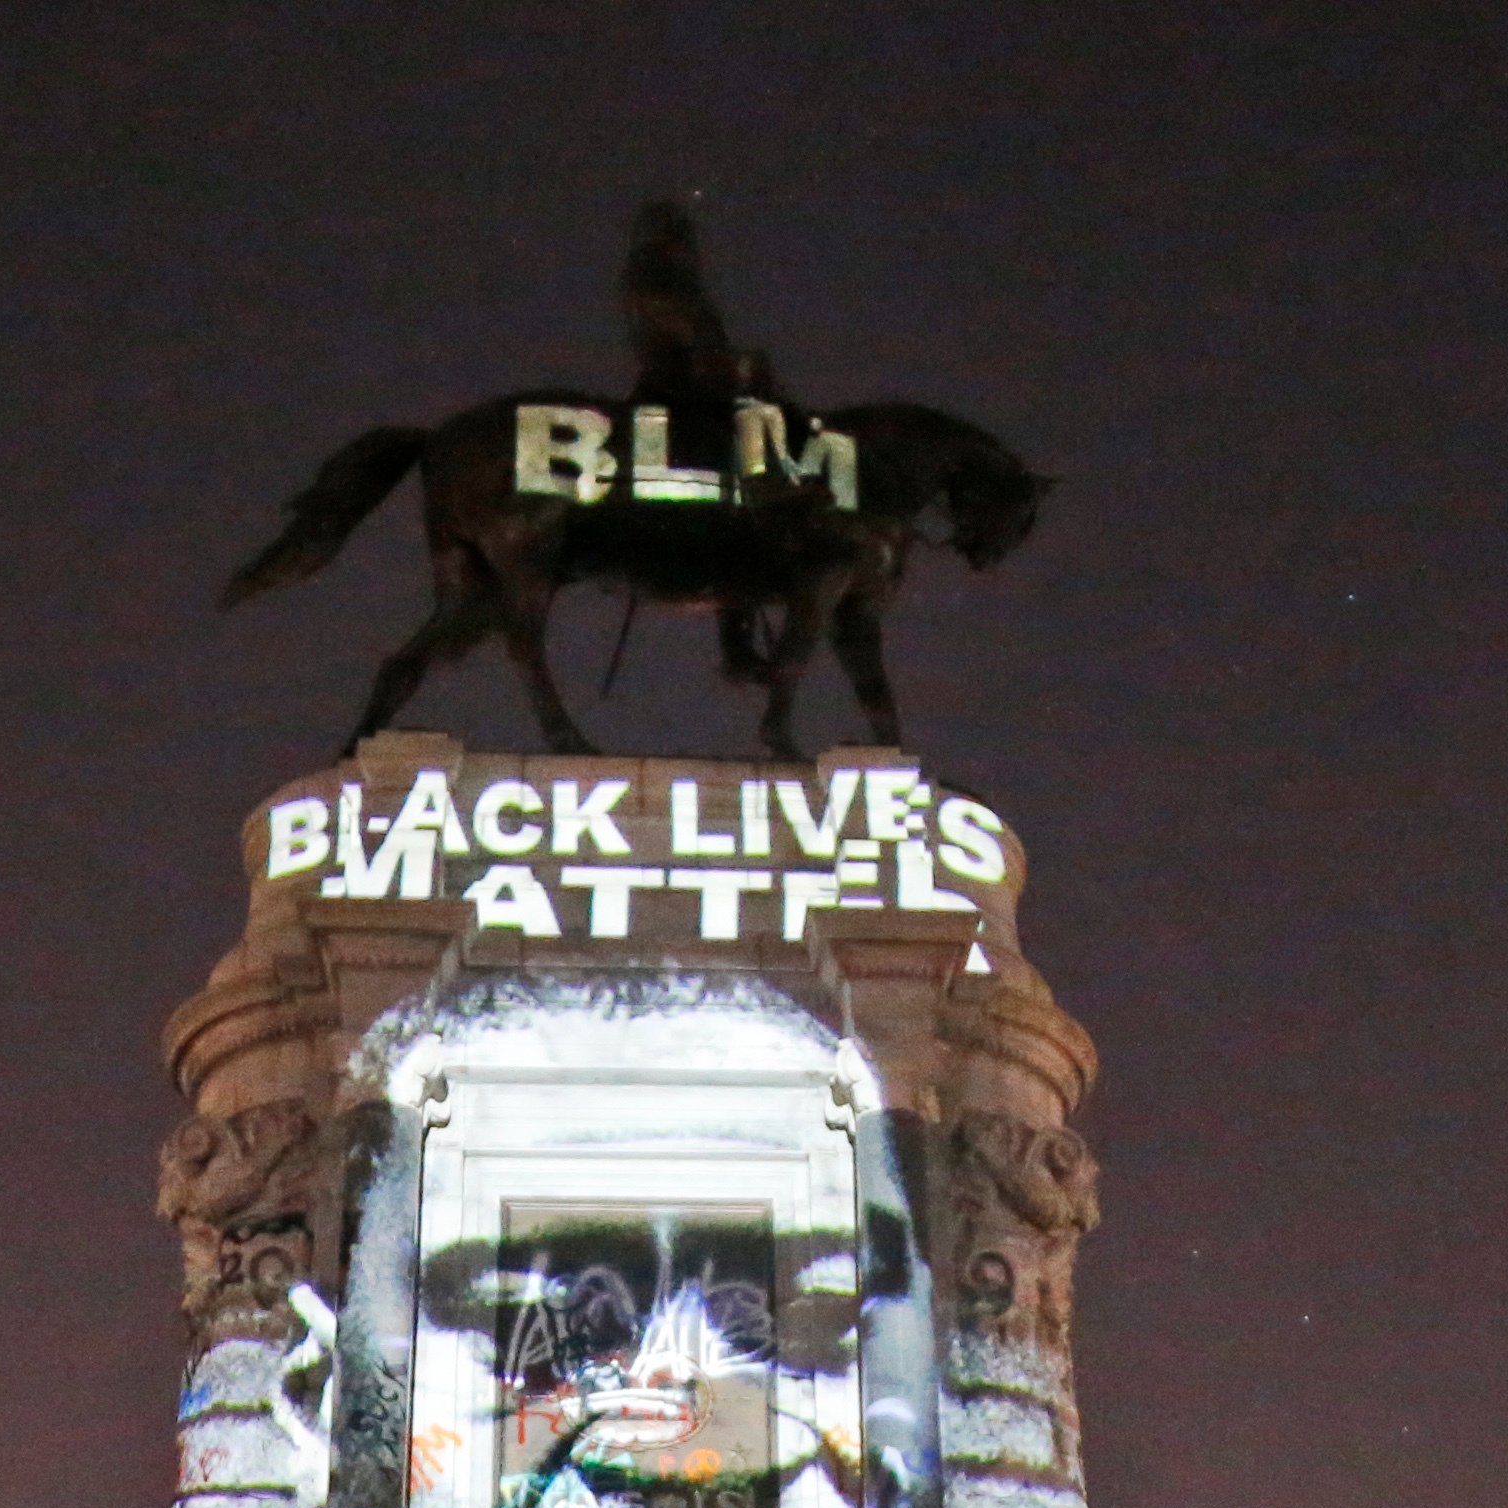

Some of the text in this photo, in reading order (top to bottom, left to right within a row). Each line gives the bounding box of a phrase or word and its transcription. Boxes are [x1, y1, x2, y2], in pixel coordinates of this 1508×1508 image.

[514, 398, 859, 511] BLM
[267, 768, 1006, 883] BLACK LIVES
